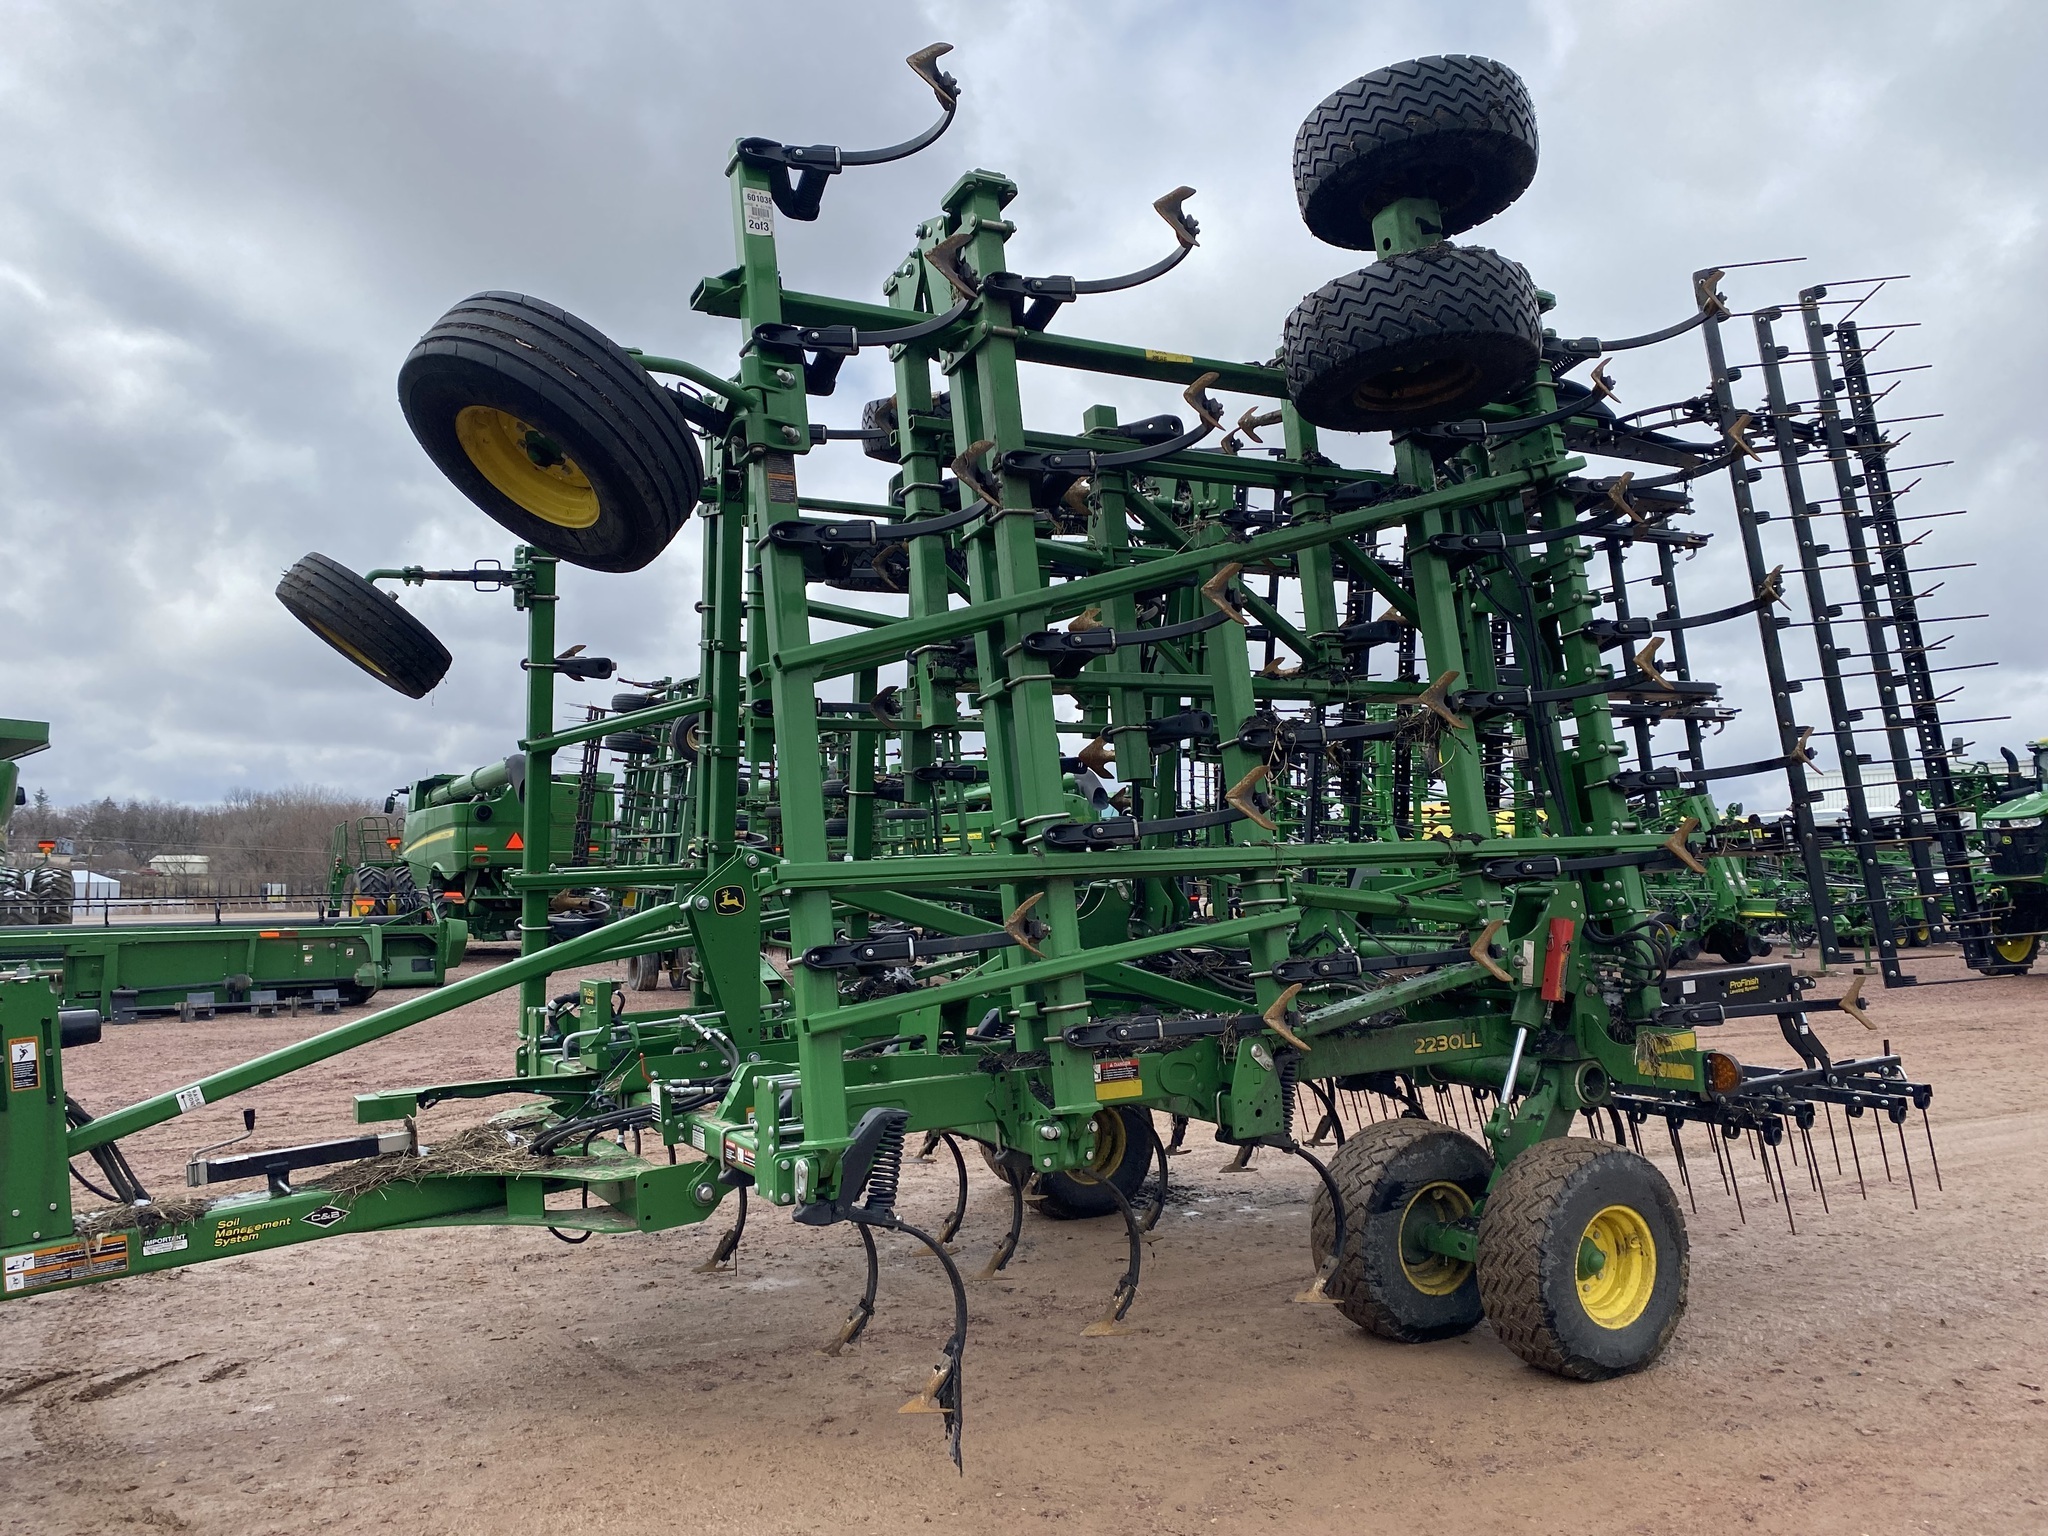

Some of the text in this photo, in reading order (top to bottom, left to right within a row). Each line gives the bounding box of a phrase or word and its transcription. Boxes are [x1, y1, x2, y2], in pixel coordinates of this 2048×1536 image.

[1729, 977, 1759, 990] ProFinish
[1414, 1032, 1483, 1055] 2230LL
[217, 1217, 240, 1229] Soil
[311, 1211, 340, 1222] C&B
[215, 1217, 292, 1239] Management
[214, 1232, 260, 1247] System
